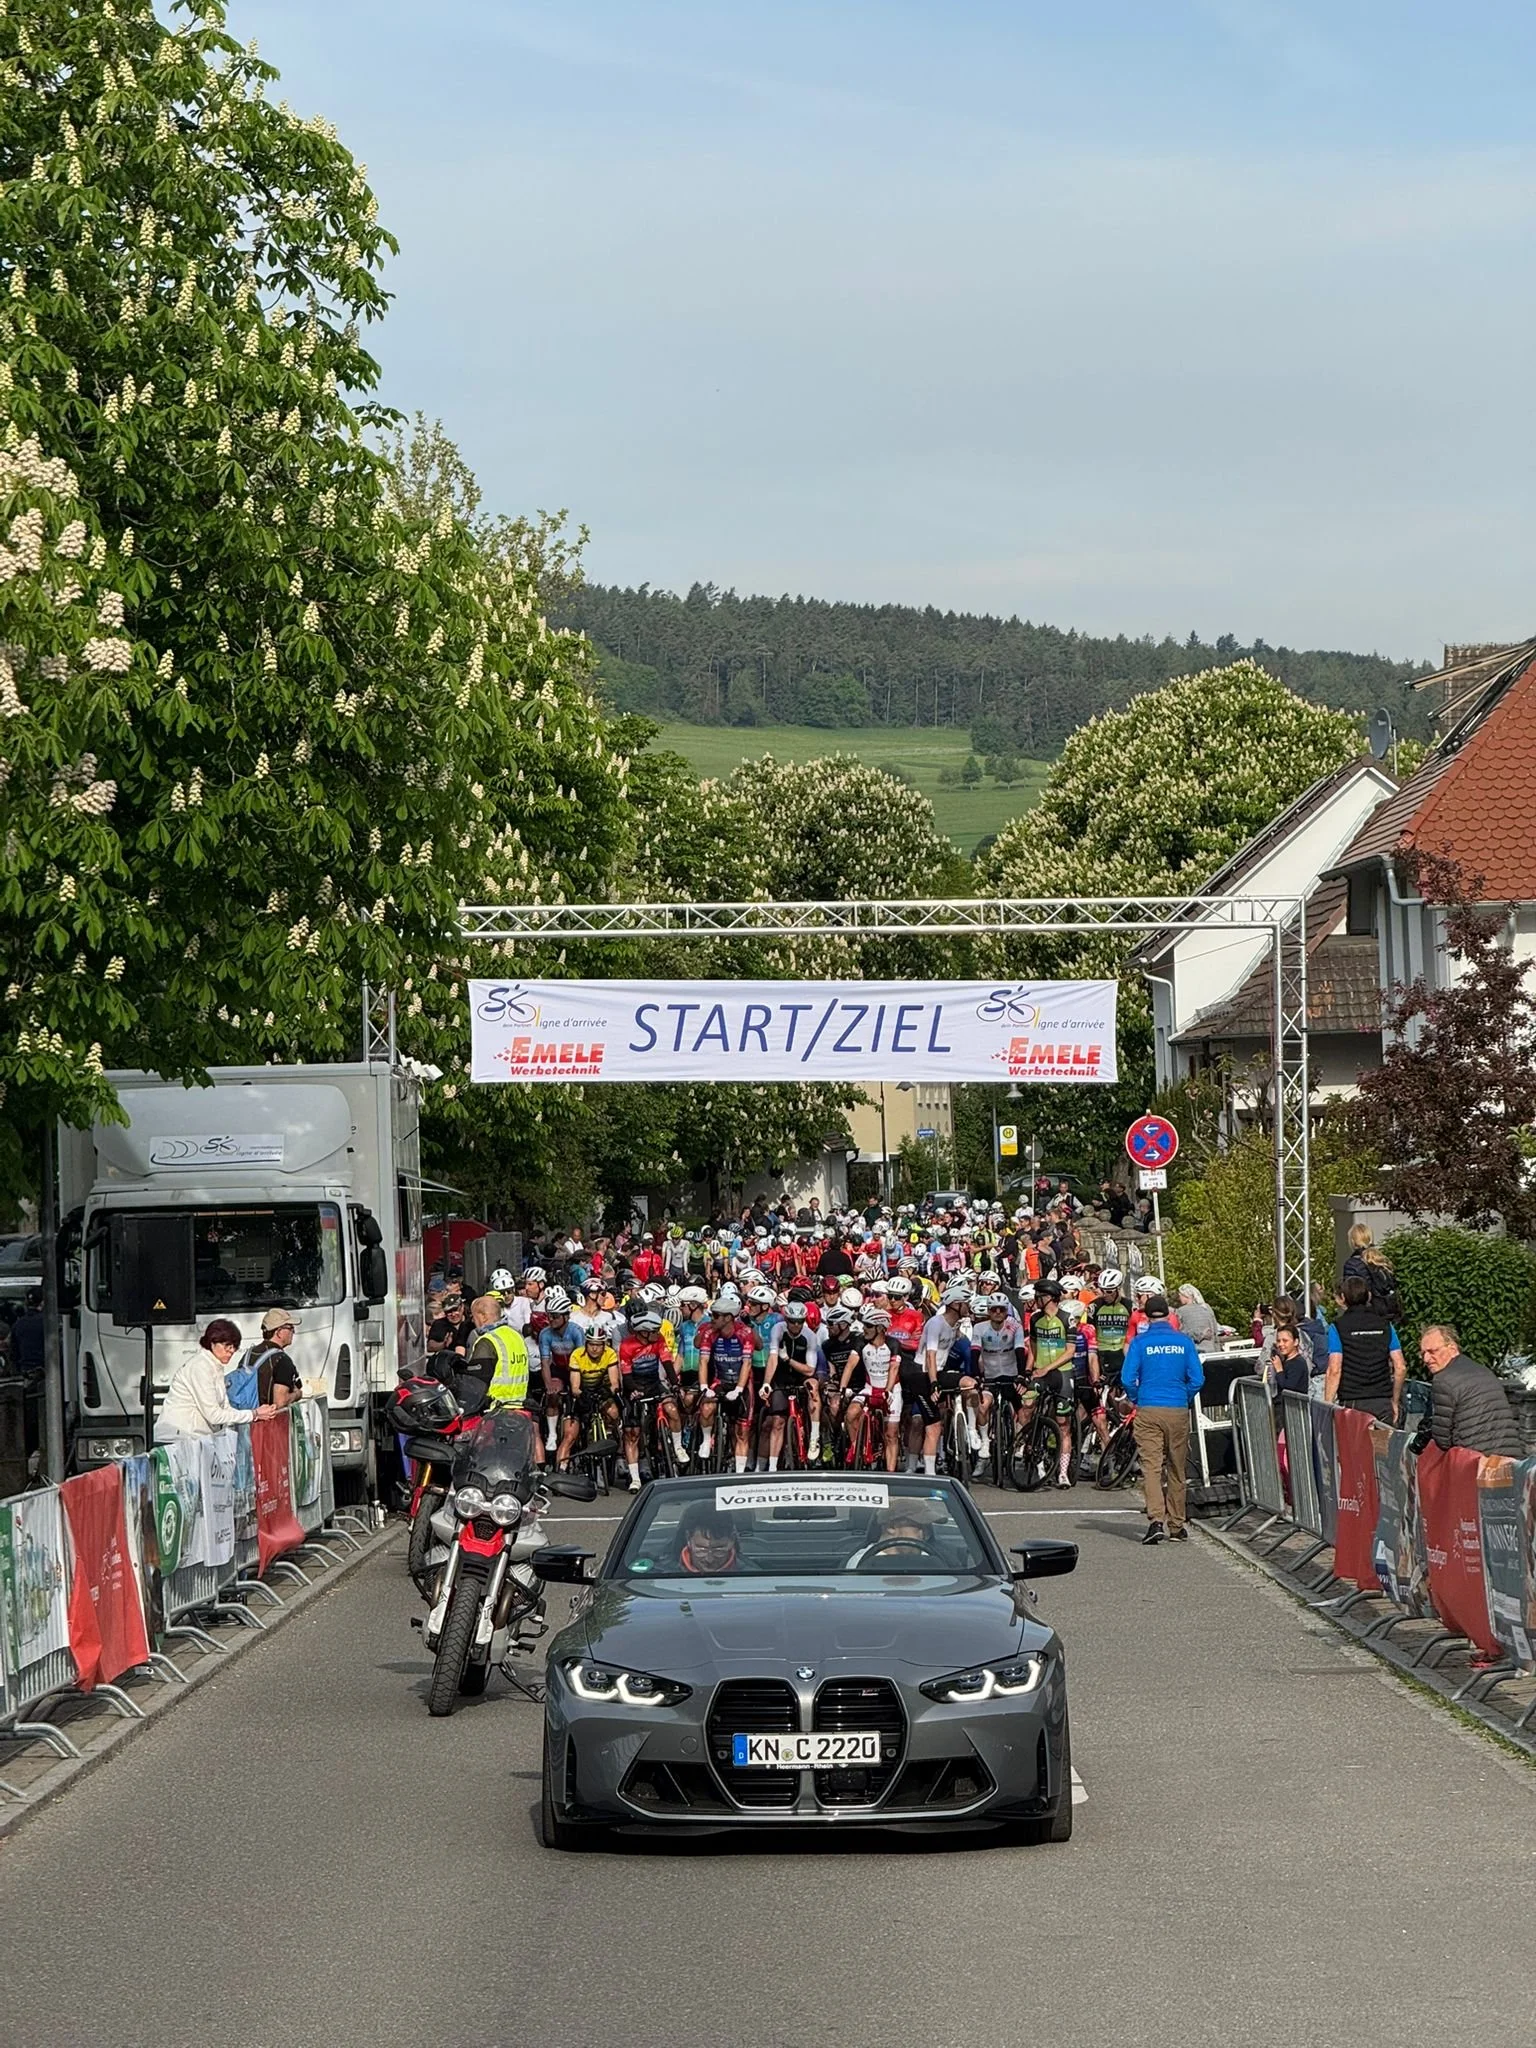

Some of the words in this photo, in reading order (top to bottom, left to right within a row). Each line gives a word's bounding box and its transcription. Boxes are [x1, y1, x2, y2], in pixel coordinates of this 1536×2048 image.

[563, 1016, 608, 1028] d'arrivée
[1061, 1018, 1105, 1030] d'arrivée
[628, 998, 951, 1062] START/ZIEL
[510, 1036, 605, 1064] EMELE
[1007, 1037, 1102, 1065] EMELE
[510, 1064, 601, 1076] Werbetechnik
[1007, 1065, 1100, 1077] Werbetechnik
[1146, 1345, 1185, 1355] BAYERN
[510, 1351, 527, 1366] Jury
[720, 1492, 884, 1505] Vorausfahrzeug
[749, 1738, 780, 1761] KN
[796, 1738, 811, 1760] C
[816, 1736, 876, 1760] 2220
